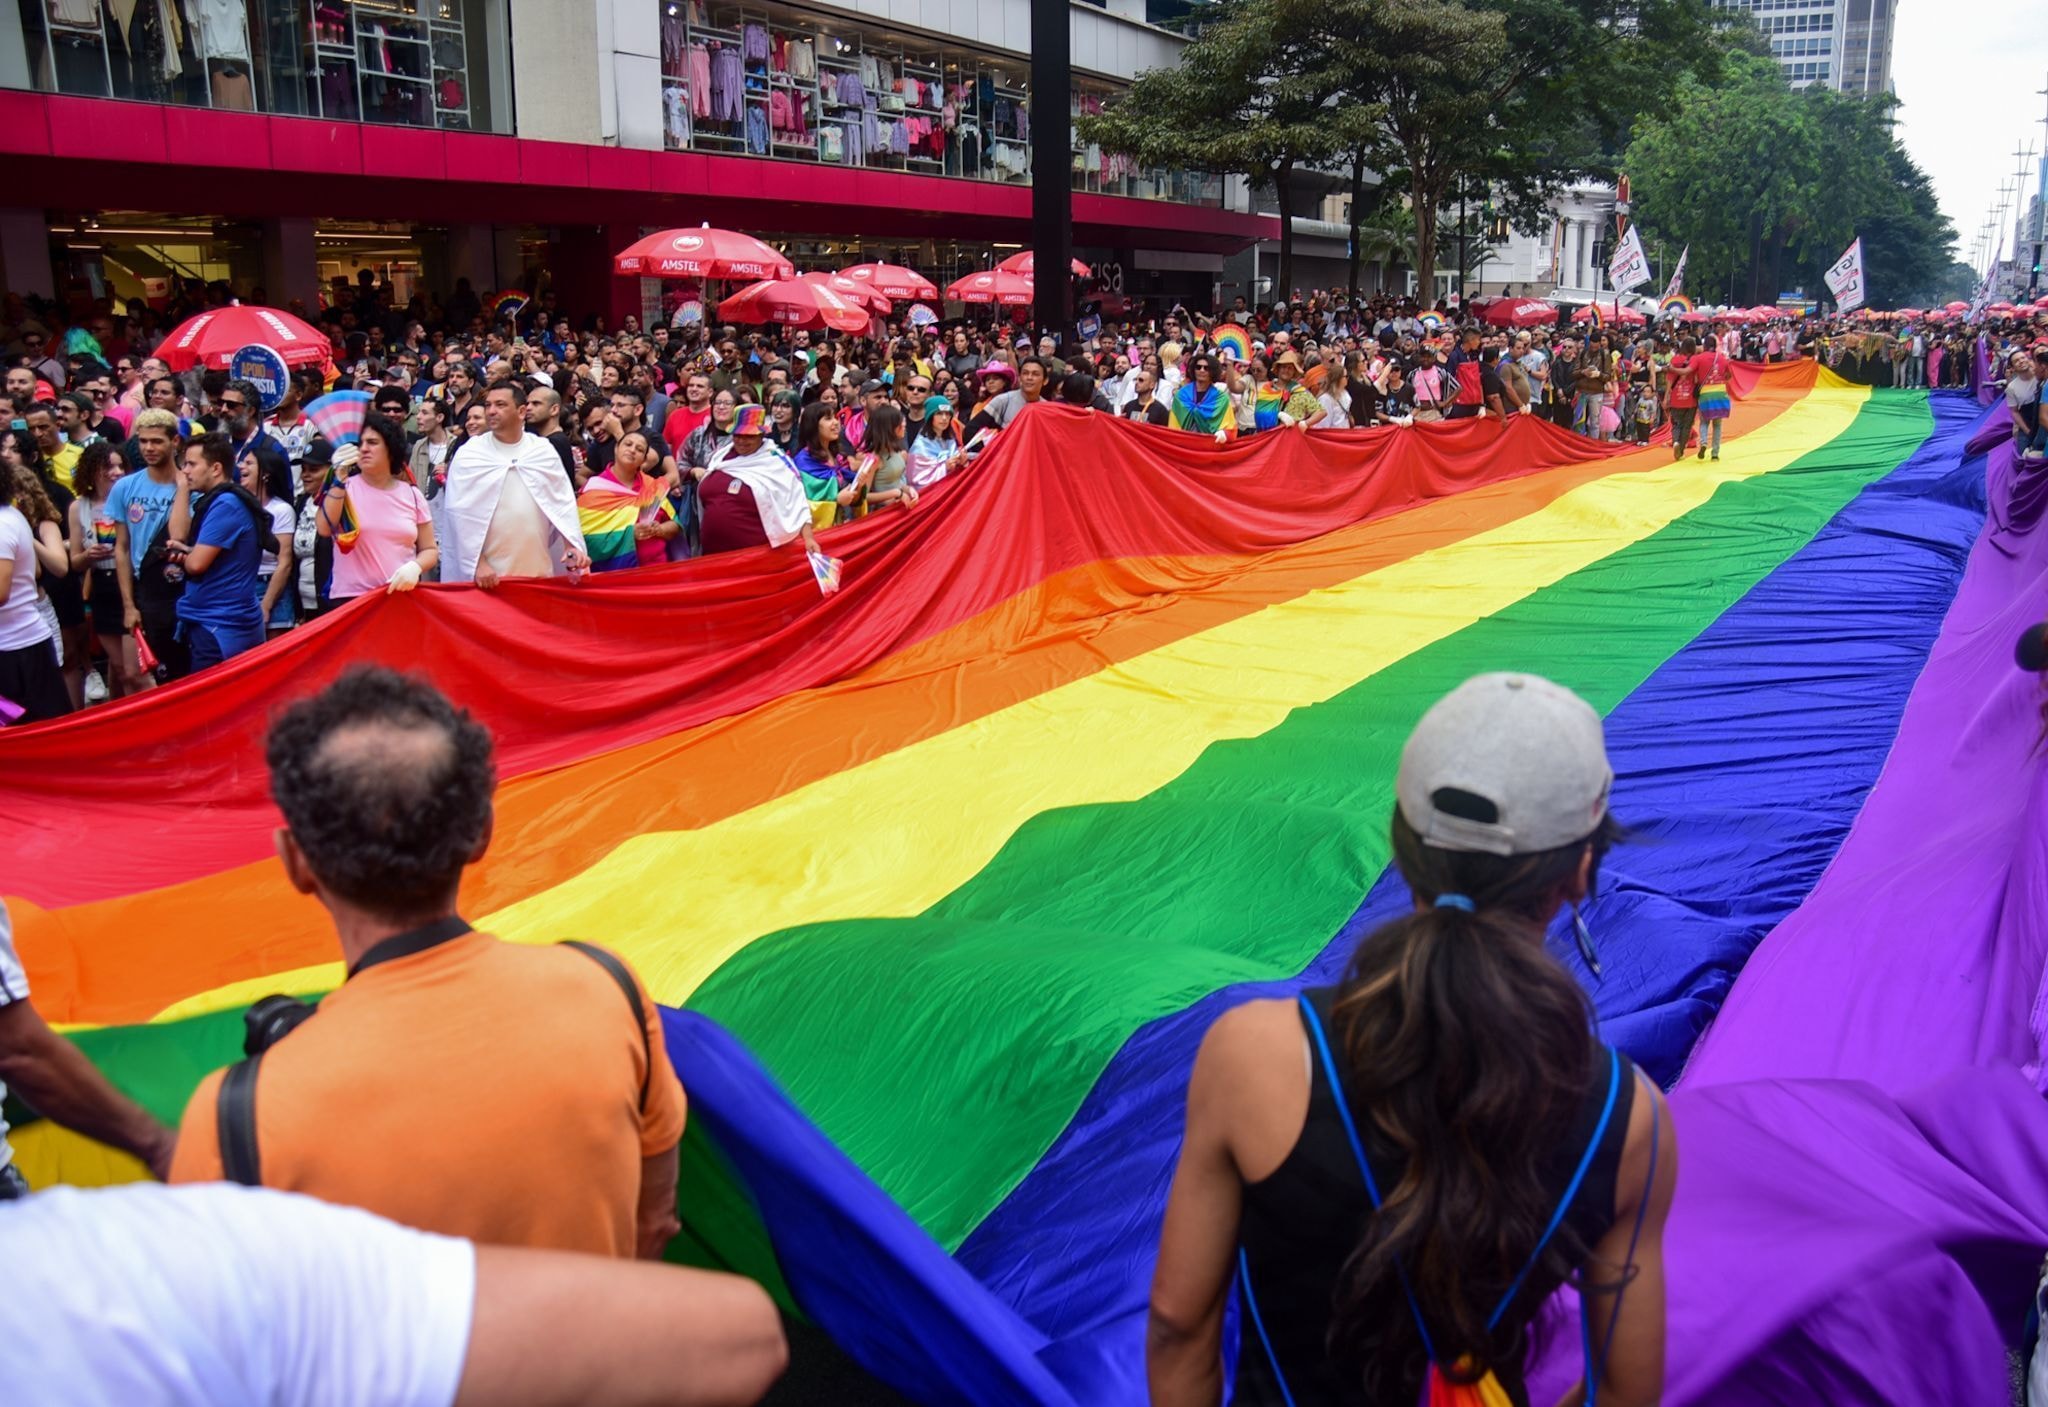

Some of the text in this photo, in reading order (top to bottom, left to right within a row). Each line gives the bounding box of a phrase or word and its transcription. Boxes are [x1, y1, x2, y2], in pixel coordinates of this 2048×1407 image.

[621, 258, 640, 269] AMSTEL
[661, 259, 700, 272] AMSTEL
[730, 263, 764, 275] AMSTEL
[883, 287, 908, 295] AMSTEL
[177, 315, 215, 348] BRAHMA
[255, 311, 297, 341] BRAHMA
